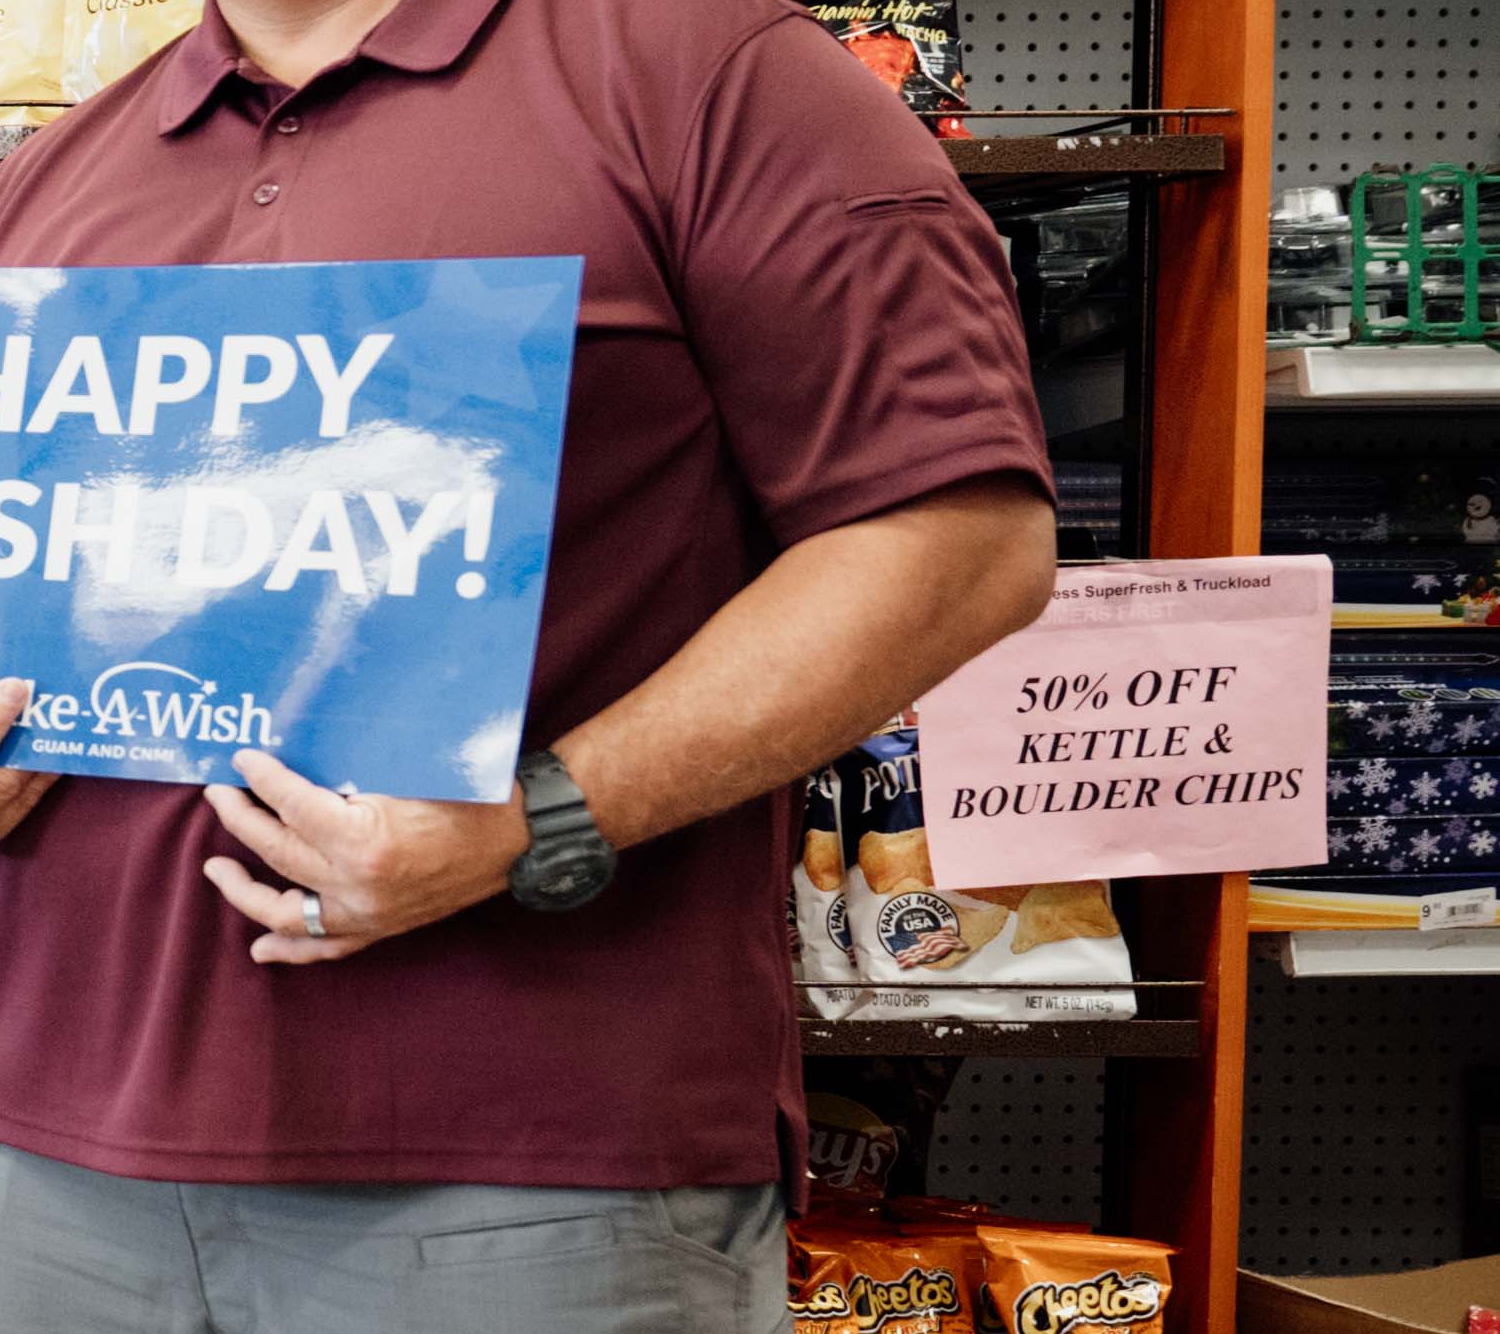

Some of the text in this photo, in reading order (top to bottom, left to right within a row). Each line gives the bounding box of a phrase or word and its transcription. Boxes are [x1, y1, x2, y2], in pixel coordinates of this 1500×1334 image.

[172, 487, 497, 600] DAY!
[1085, 580, 1172, 600] SuperFresh
[1176, 580, 1188, 593] &
[1192, 575, 1272, 592] Truckload
[1015, 665, 1238, 714] 50% OFF
[32, 738, 175, 762] GUAM AND CNMI
[1016, 723, 1235, 765] KETTLE &
[861, 754, 922, 813] POT
[949, 767, 1305, 820] BOULDER CHIPS
[881, 895, 913, 933] FAMILY
[915, 895, 951, 922] MADE
[902, 918, 934, 931] USA
[873, 993, 930, 1008] OTATO CHIPS
[1025, 996, 1043, 1009] NET
[851, 1271, 957, 1332] Cheetos
